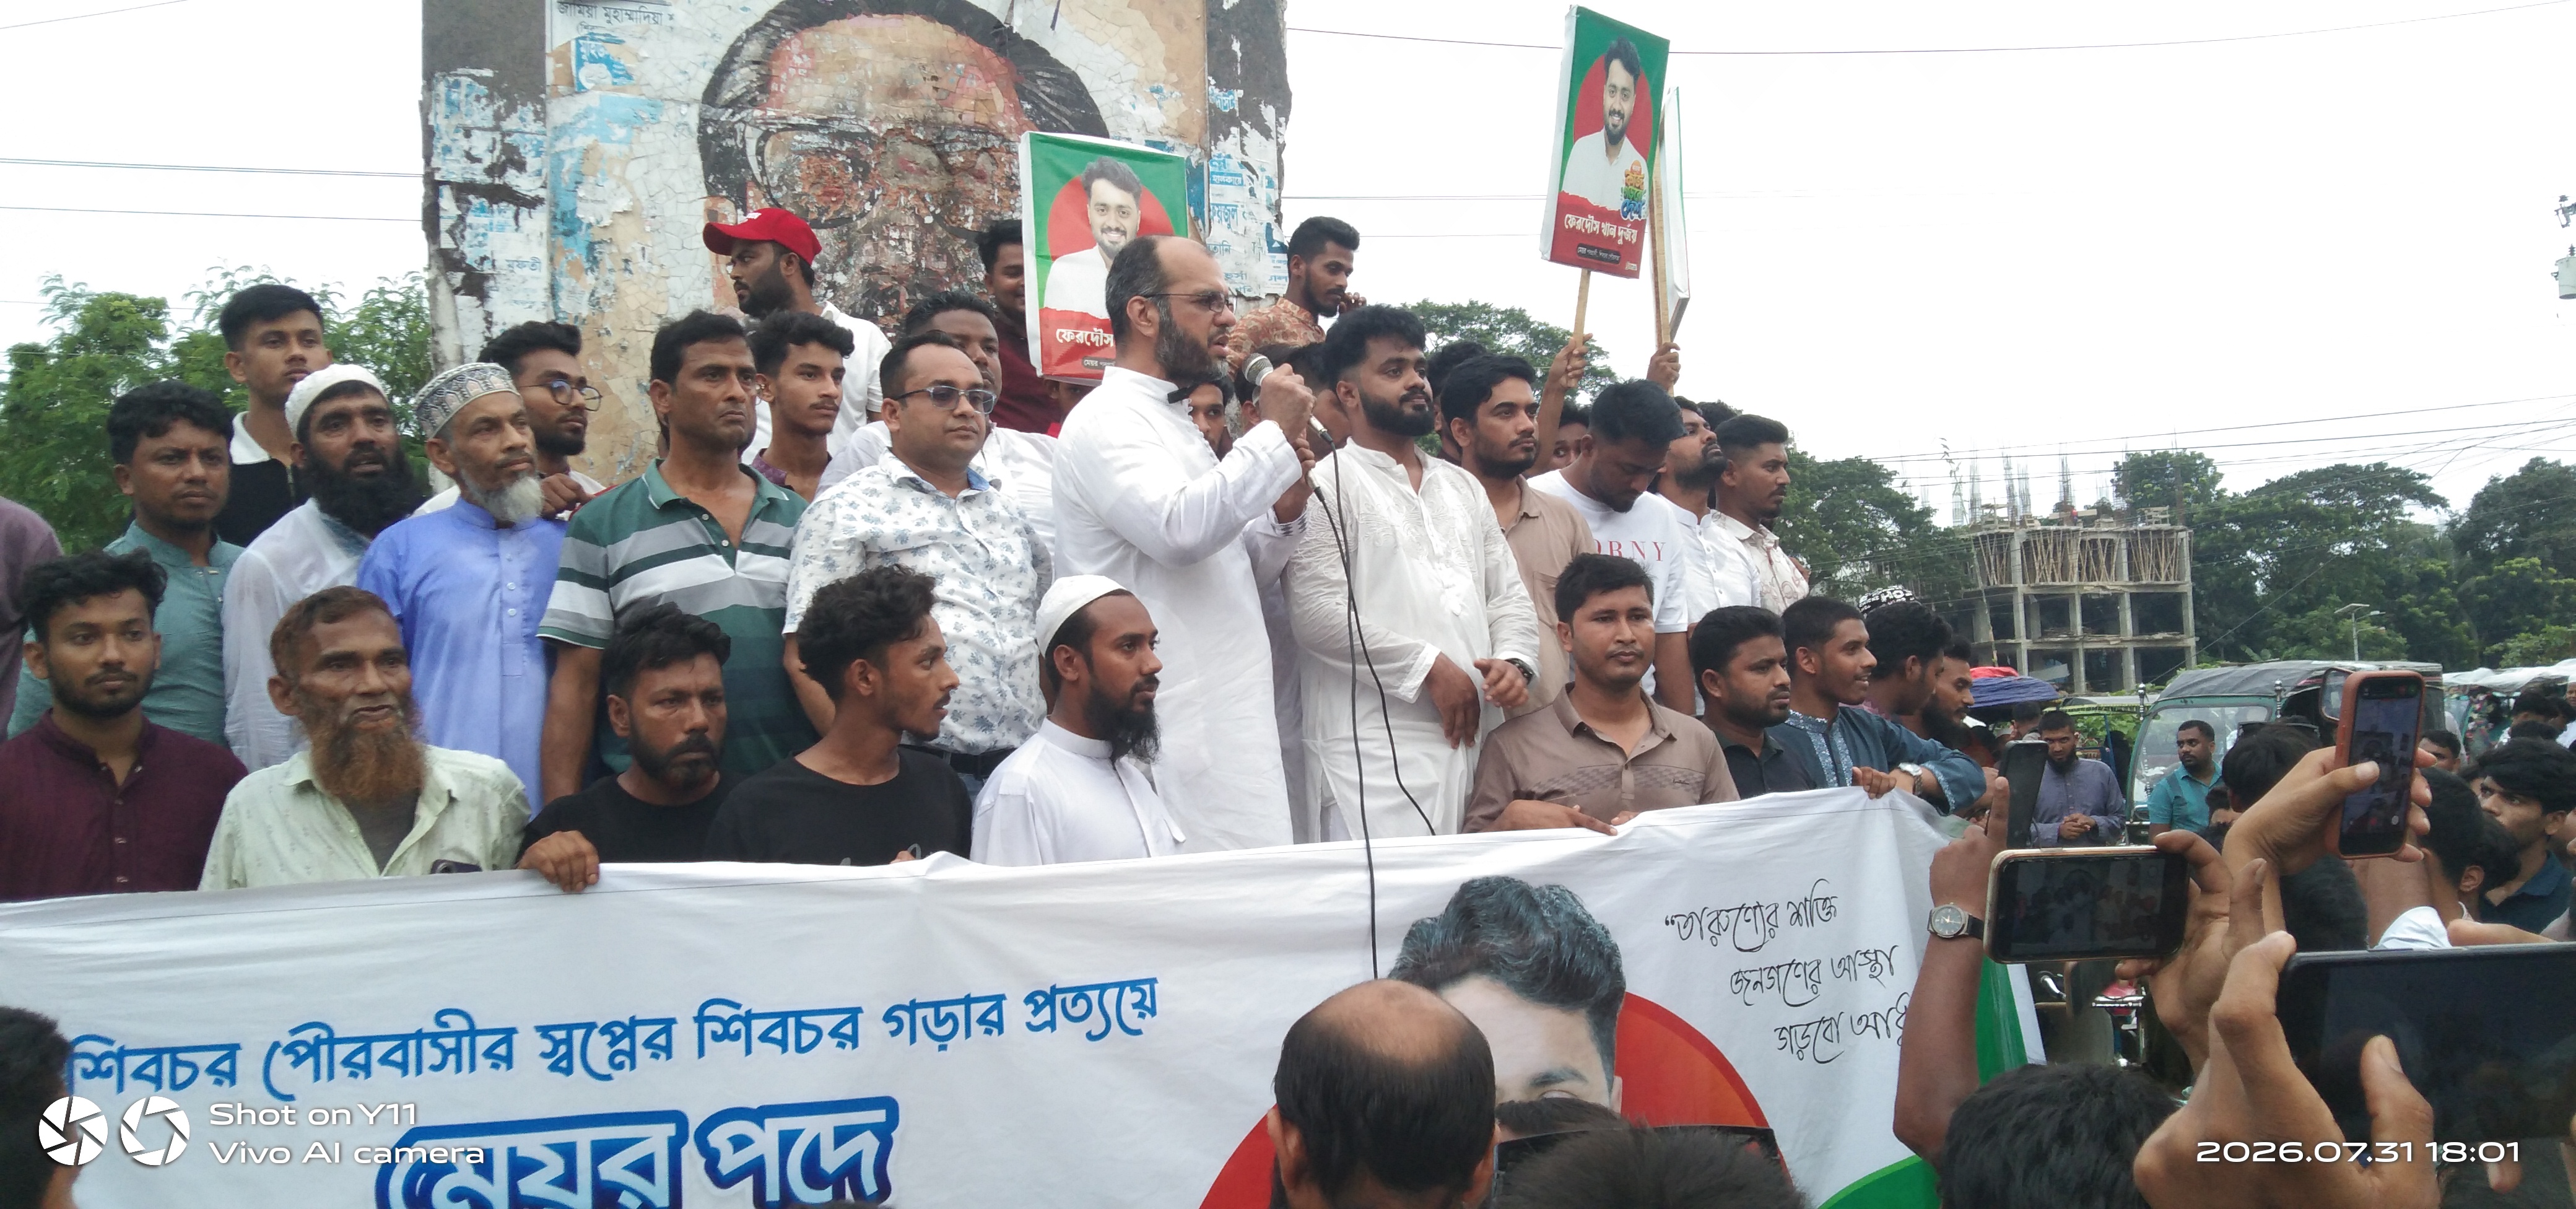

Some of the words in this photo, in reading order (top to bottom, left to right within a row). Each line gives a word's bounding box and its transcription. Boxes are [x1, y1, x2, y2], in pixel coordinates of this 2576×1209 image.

[1564, 214, 1601, 234] ফেরদৌস
[1601, 221, 1617, 238] খান
[1617, 223, 1638, 245] দুর্জয়
[1056, 328, 1114, 347] ফেরদৌস
[1786, 878, 1838, 928] শক্তি
[1730, 959, 1822, 1007] জনগণের
[1830, 945, 1899, 989] আস্থা
[66, 1034, 242, 1095] শিবচর
[263, 1008, 518, 1102] পৌরবাসীর
[534, 1015, 677, 1081] স্বপ্নের
[693, 998, 863, 1059] শিবচর
[882, 993, 1007, 1052] গড়ার
[1023, 977, 1159, 1042] প্রত্যয়ে
[1773, 1011, 1845, 1064] গড়বো
[694, 1096, 900, 1209] পদে
